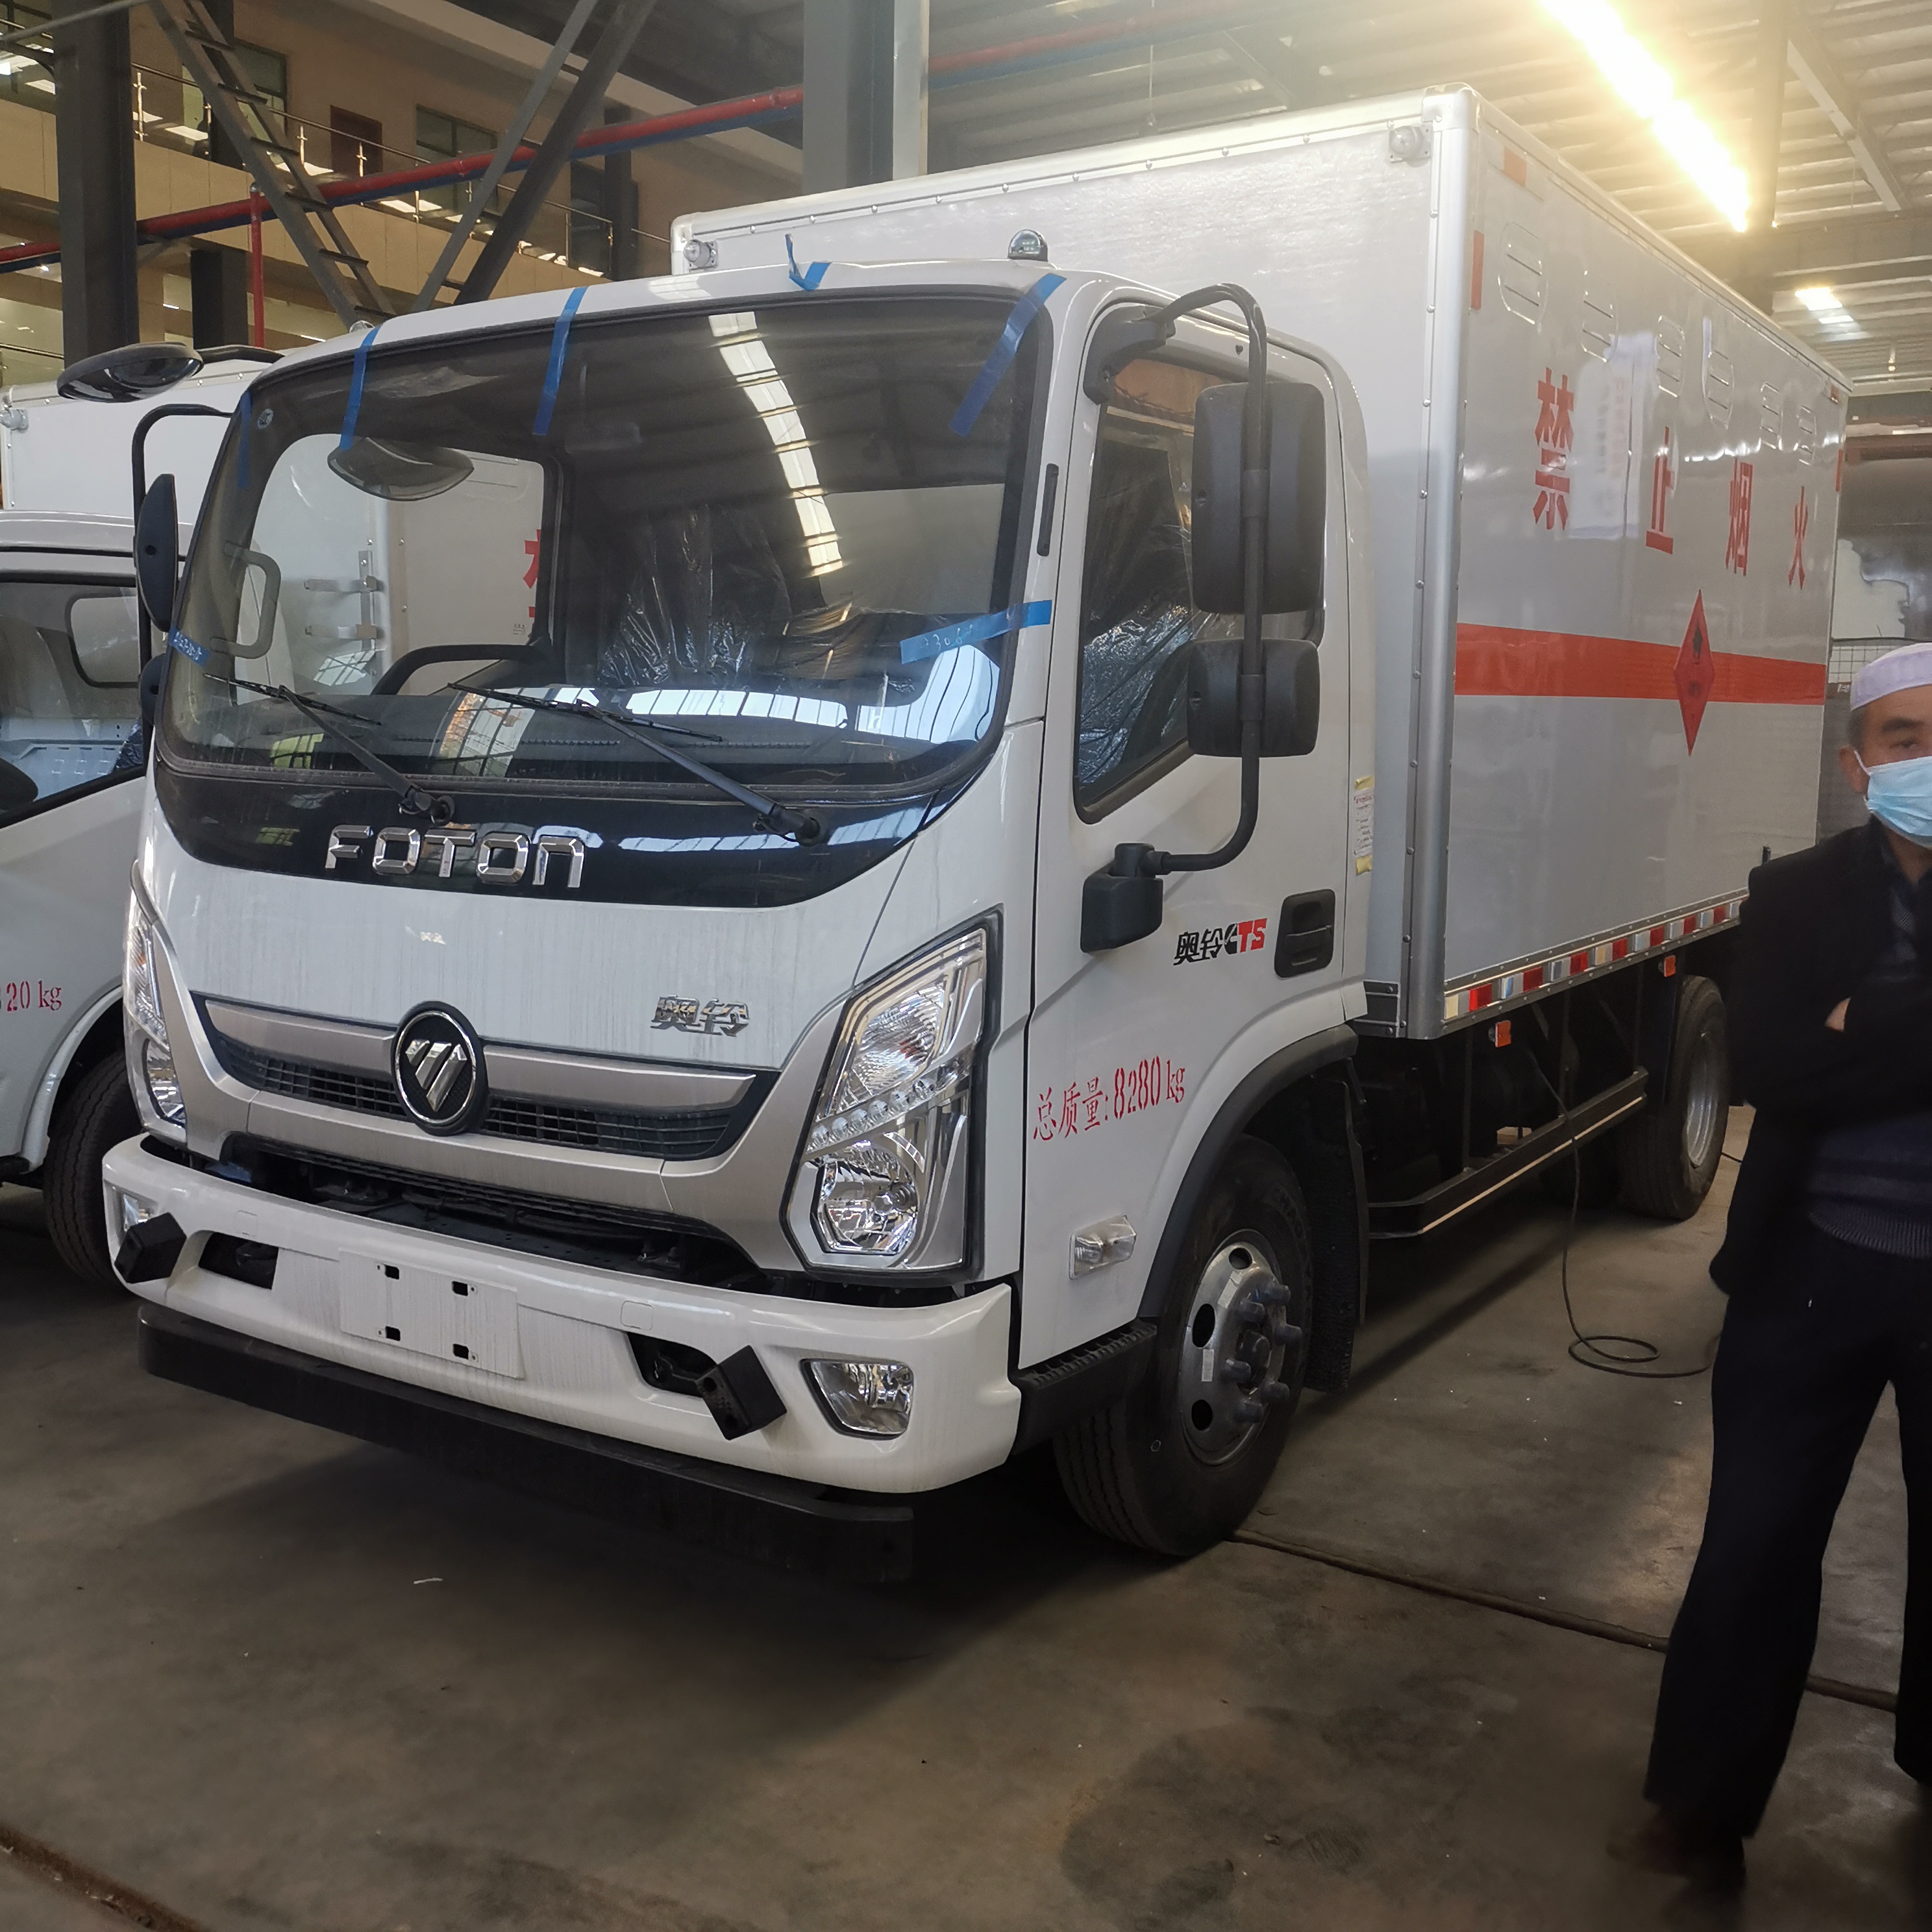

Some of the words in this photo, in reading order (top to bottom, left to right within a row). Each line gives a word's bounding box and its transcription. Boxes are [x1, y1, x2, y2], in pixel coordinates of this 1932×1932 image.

[1533, 367, 1808, 589] 禁止烟火
[325, 824, 585, 889] FOTON
[0, 980, 31, 1011] 20
[38, 980, 62, 1011] kg
[650, 995, 750, 1037] 奥铃
[1166, 1060, 1185, 1104] kg
